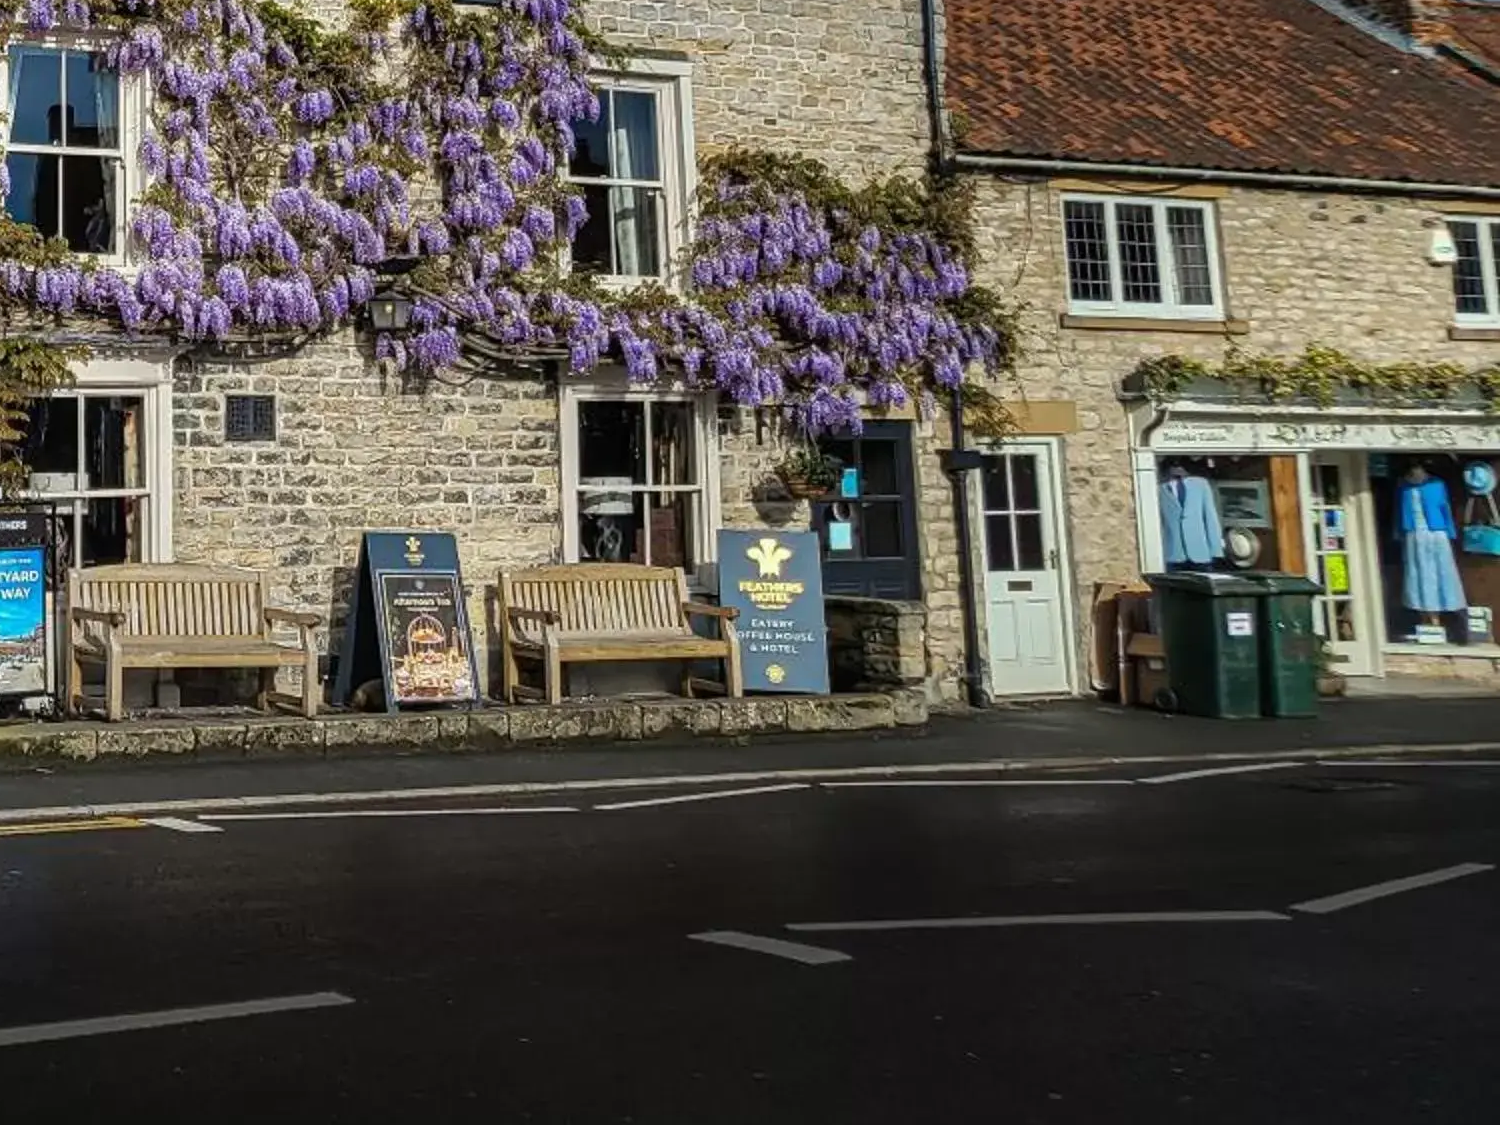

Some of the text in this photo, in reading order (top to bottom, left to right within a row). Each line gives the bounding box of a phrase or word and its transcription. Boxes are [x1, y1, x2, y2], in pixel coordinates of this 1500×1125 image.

[0, 586, 31, 600] WAY
[738, 581, 804, 593] FEATHERS
[751, 592, 793, 604] HOTEL
[737, 630, 816, 642] OFFEE HOUSE
[760, 644, 800, 654] HOTEL
